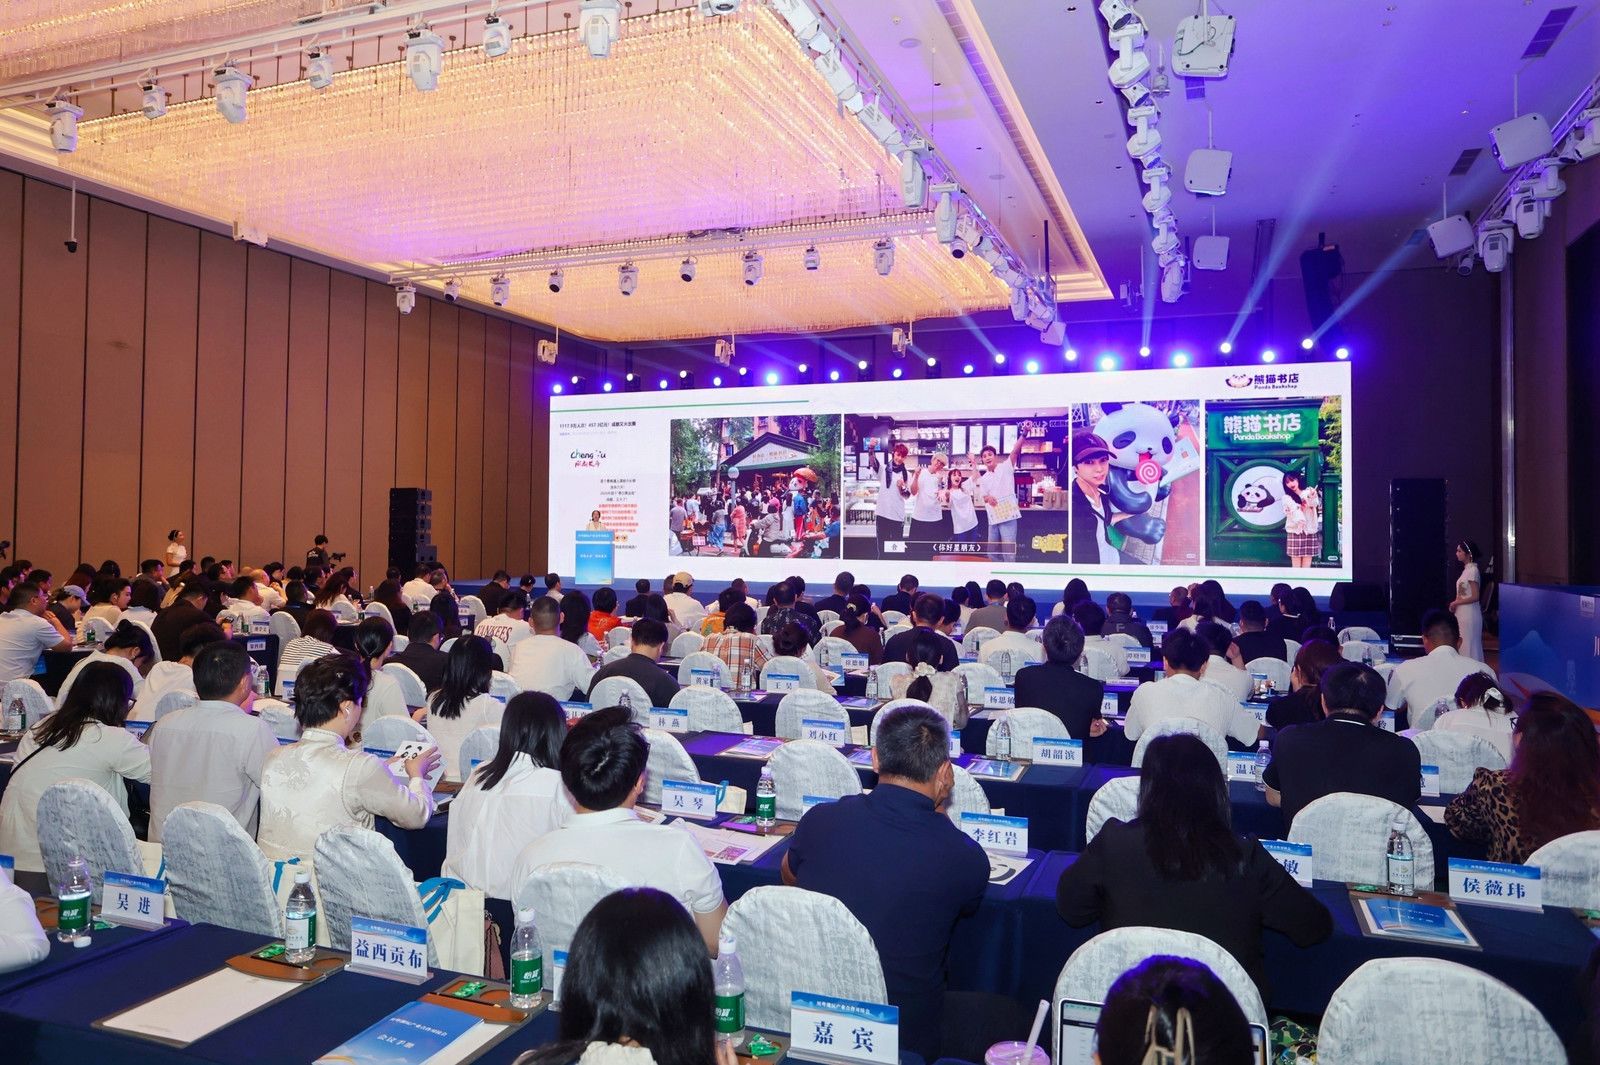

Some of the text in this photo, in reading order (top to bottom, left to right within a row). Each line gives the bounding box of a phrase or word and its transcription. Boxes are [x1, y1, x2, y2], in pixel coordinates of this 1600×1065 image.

[1254, 373, 1299, 385] 熊猫书店
[1223, 413, 1302, 434] 熊猫书店
[477, 624, 513, 644] YANKEES
[809, 730, 838, 742] 刘小红
[972, 828, 1018, 847] 李红岩
[1462, 877, 1526, 899] 侯薇玮
[116, 892, 151, 915] 吴进
[355, 938, 423, 969] 益西贡布
[813, 1020, 874, 1053] 嘉宾
